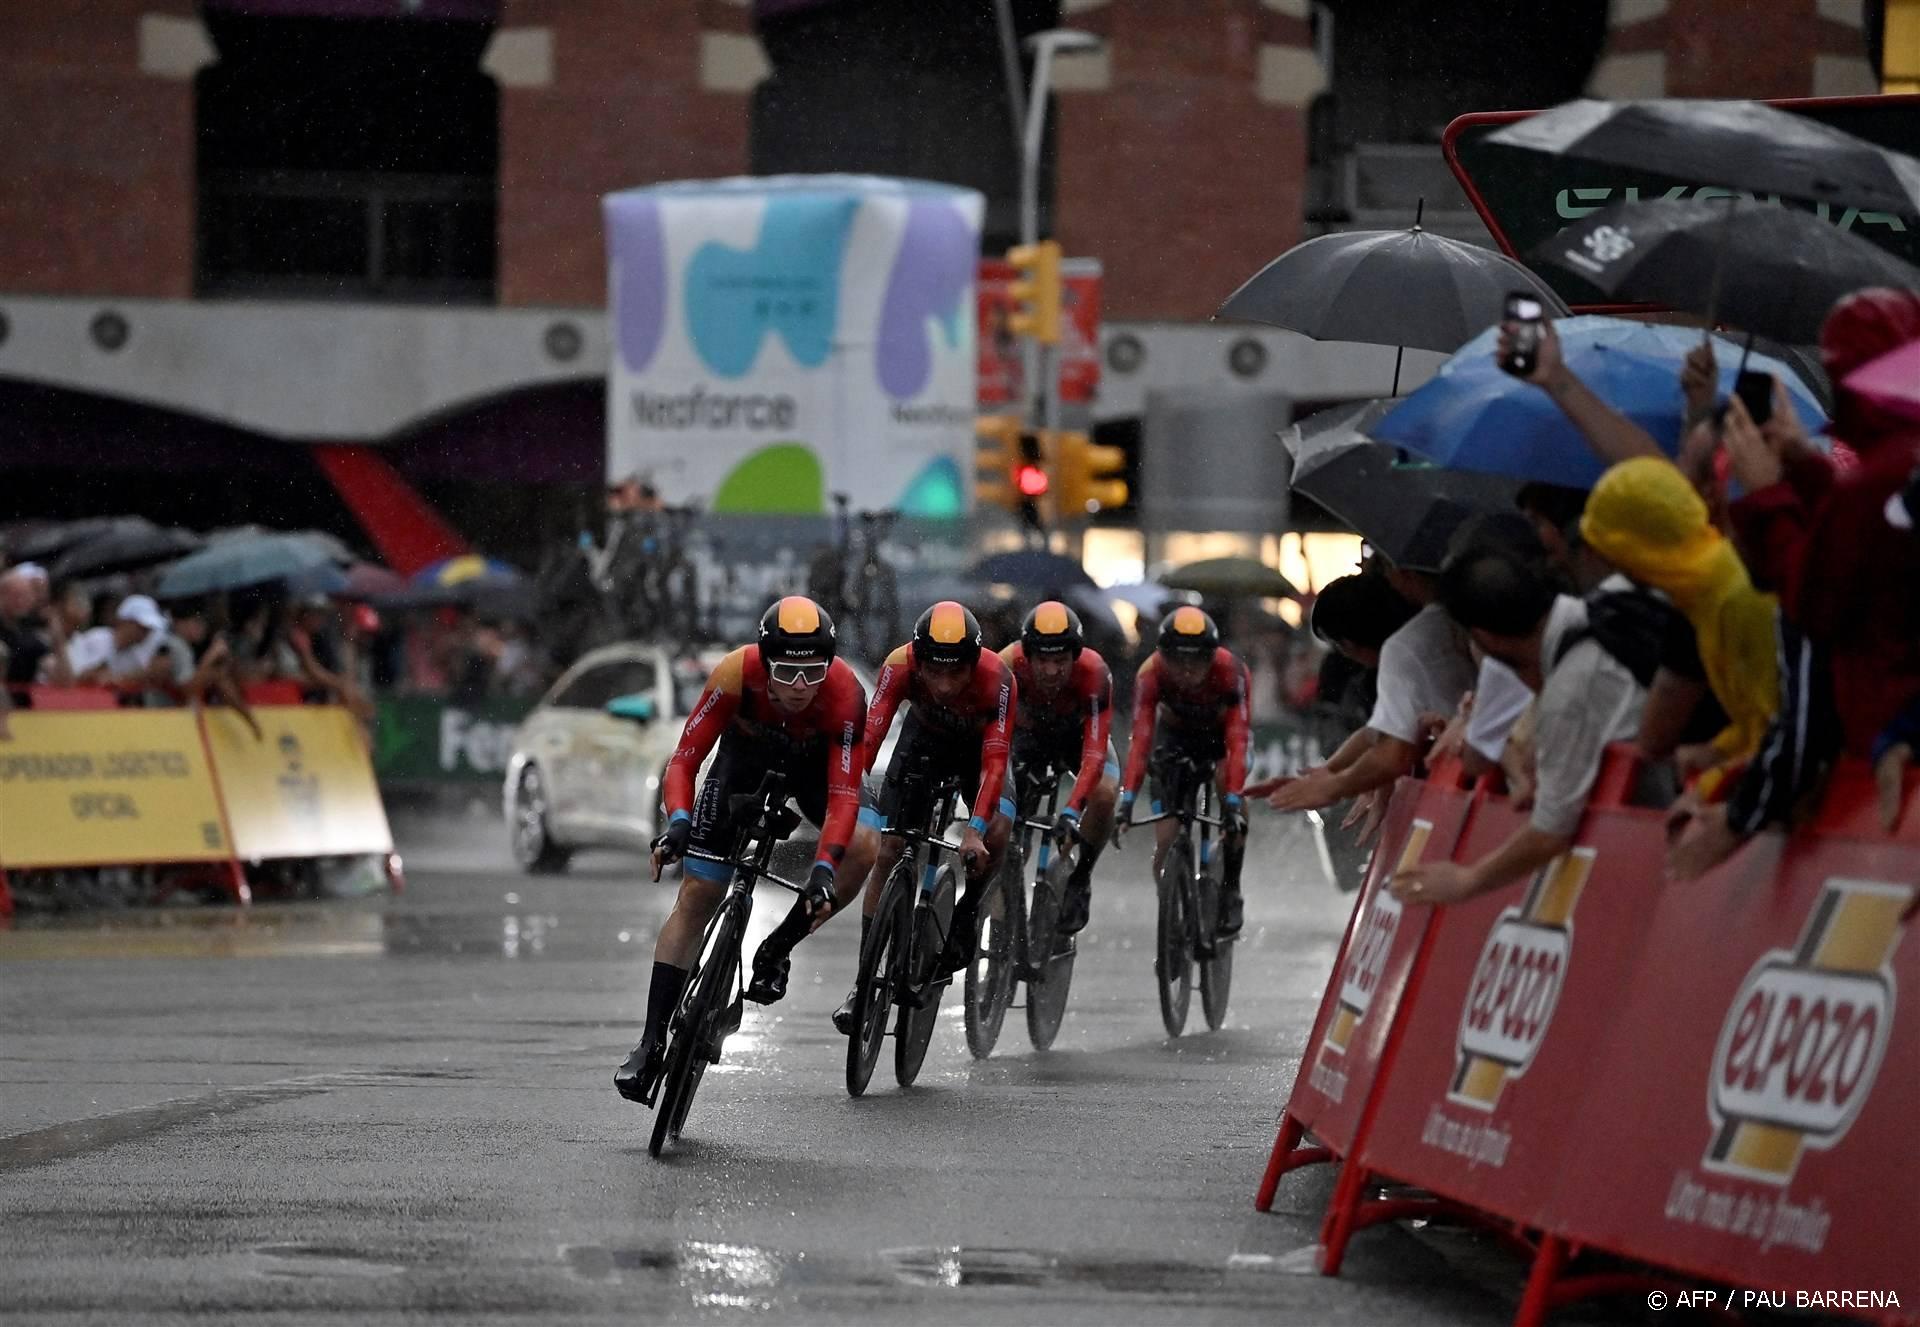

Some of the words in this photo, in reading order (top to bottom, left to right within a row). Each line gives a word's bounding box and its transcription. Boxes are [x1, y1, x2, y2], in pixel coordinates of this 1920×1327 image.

[630, 384, 797, 431] Neoforce
[685, 686, 723, 736] MERIDA
[870, 664, 894, 709] MERIDA
[996, 683, 1010, 734] MERIDA
[841, 720, 854, 775] MERIDA
